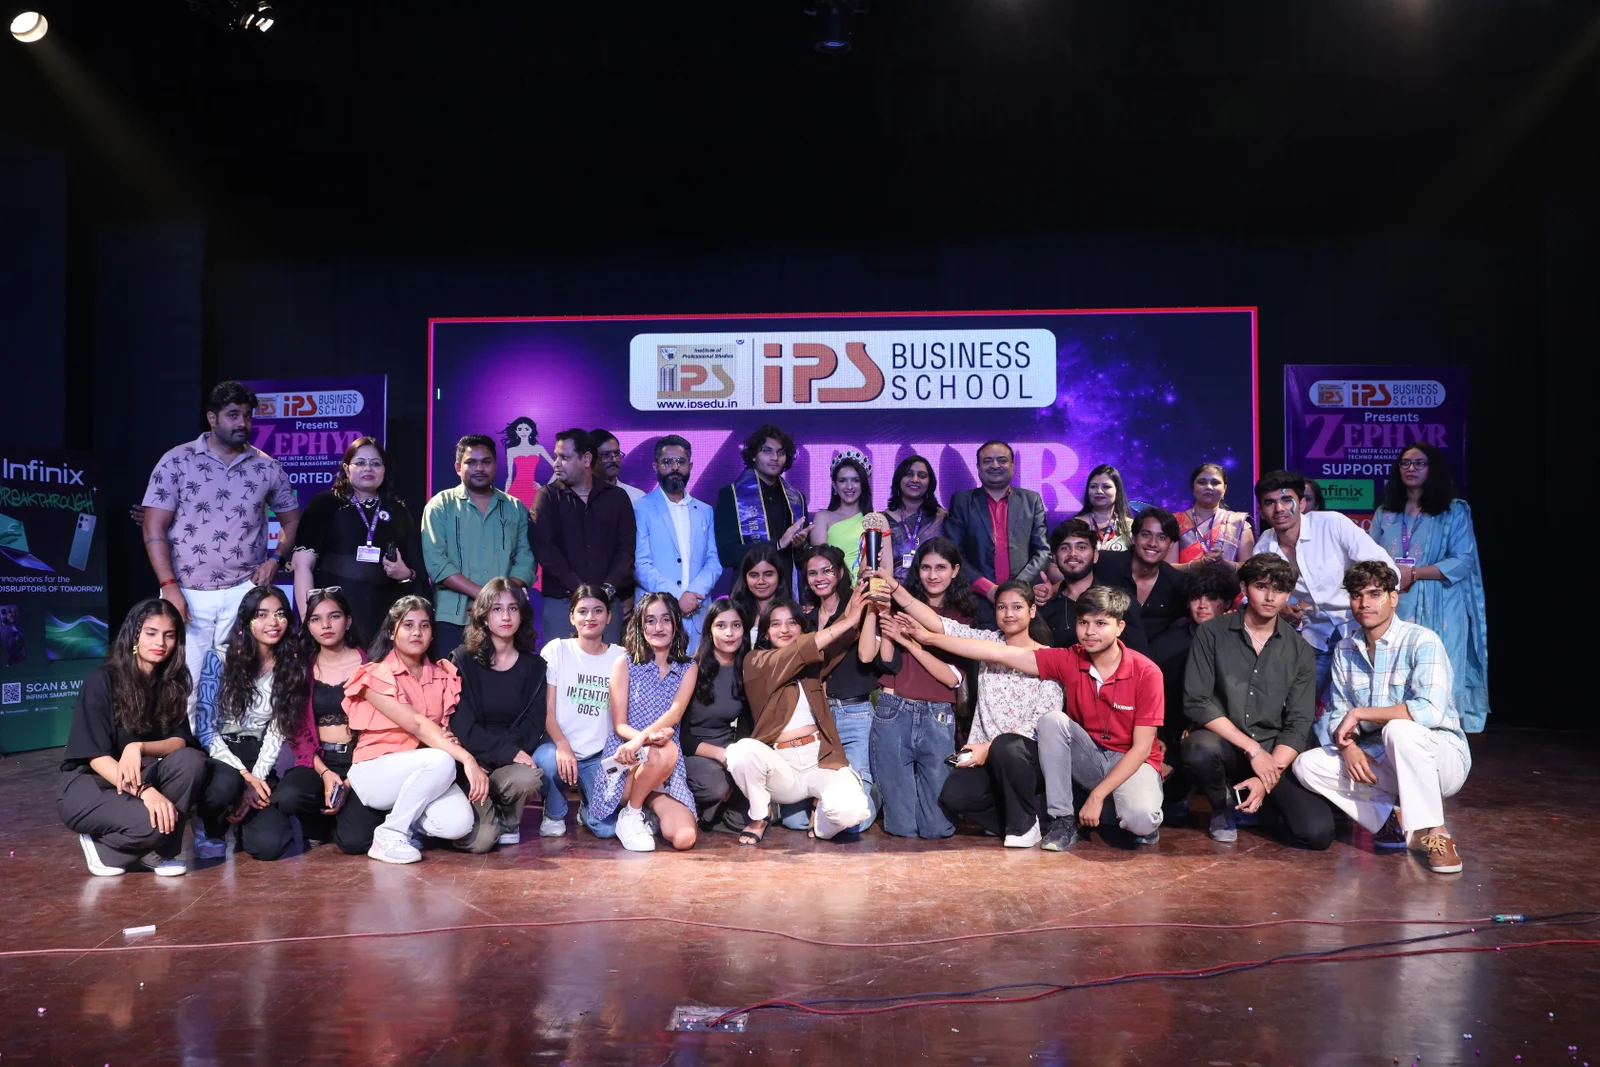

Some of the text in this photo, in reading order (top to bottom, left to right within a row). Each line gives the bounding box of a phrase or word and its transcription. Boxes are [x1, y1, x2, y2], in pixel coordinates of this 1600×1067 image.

[892, 341, 1031, 369] BUSINESS
[892, 373, 1033, 401] SCHOOL
[1393, 384, 1438, 395] BUSINESS
[318, 394, 358, 405] BUSINESS
[1393, 396, 1438, 406] SCHOOL
[318, 405, 357, 415] SCHOOL
[1364, 412, 1420, 422] Presents
[295, 421, 338, 430] Presents
[252, 424, 364, 455] ZEPHY
[1305, 414, 1448, 459] ZEPHYR
[3, 458, 85, 486] Infinix
[1322, 463, 1392, 475] SUPPORT
[289, 472, 333, 484] ORTED
[1321, 485, 1364, 496] nfinix
[44, 575, 56, 583] for
[57, 575, 71, 583] the
[0, 585, 47, 593] DISRUPTORS
[26, 680, 84, 692] SCAN & WI
[577, 673, 610, 688] WHERE
[566, 686, 610, 702] INTENTIO
[577, 703, 601, 717] GOES
